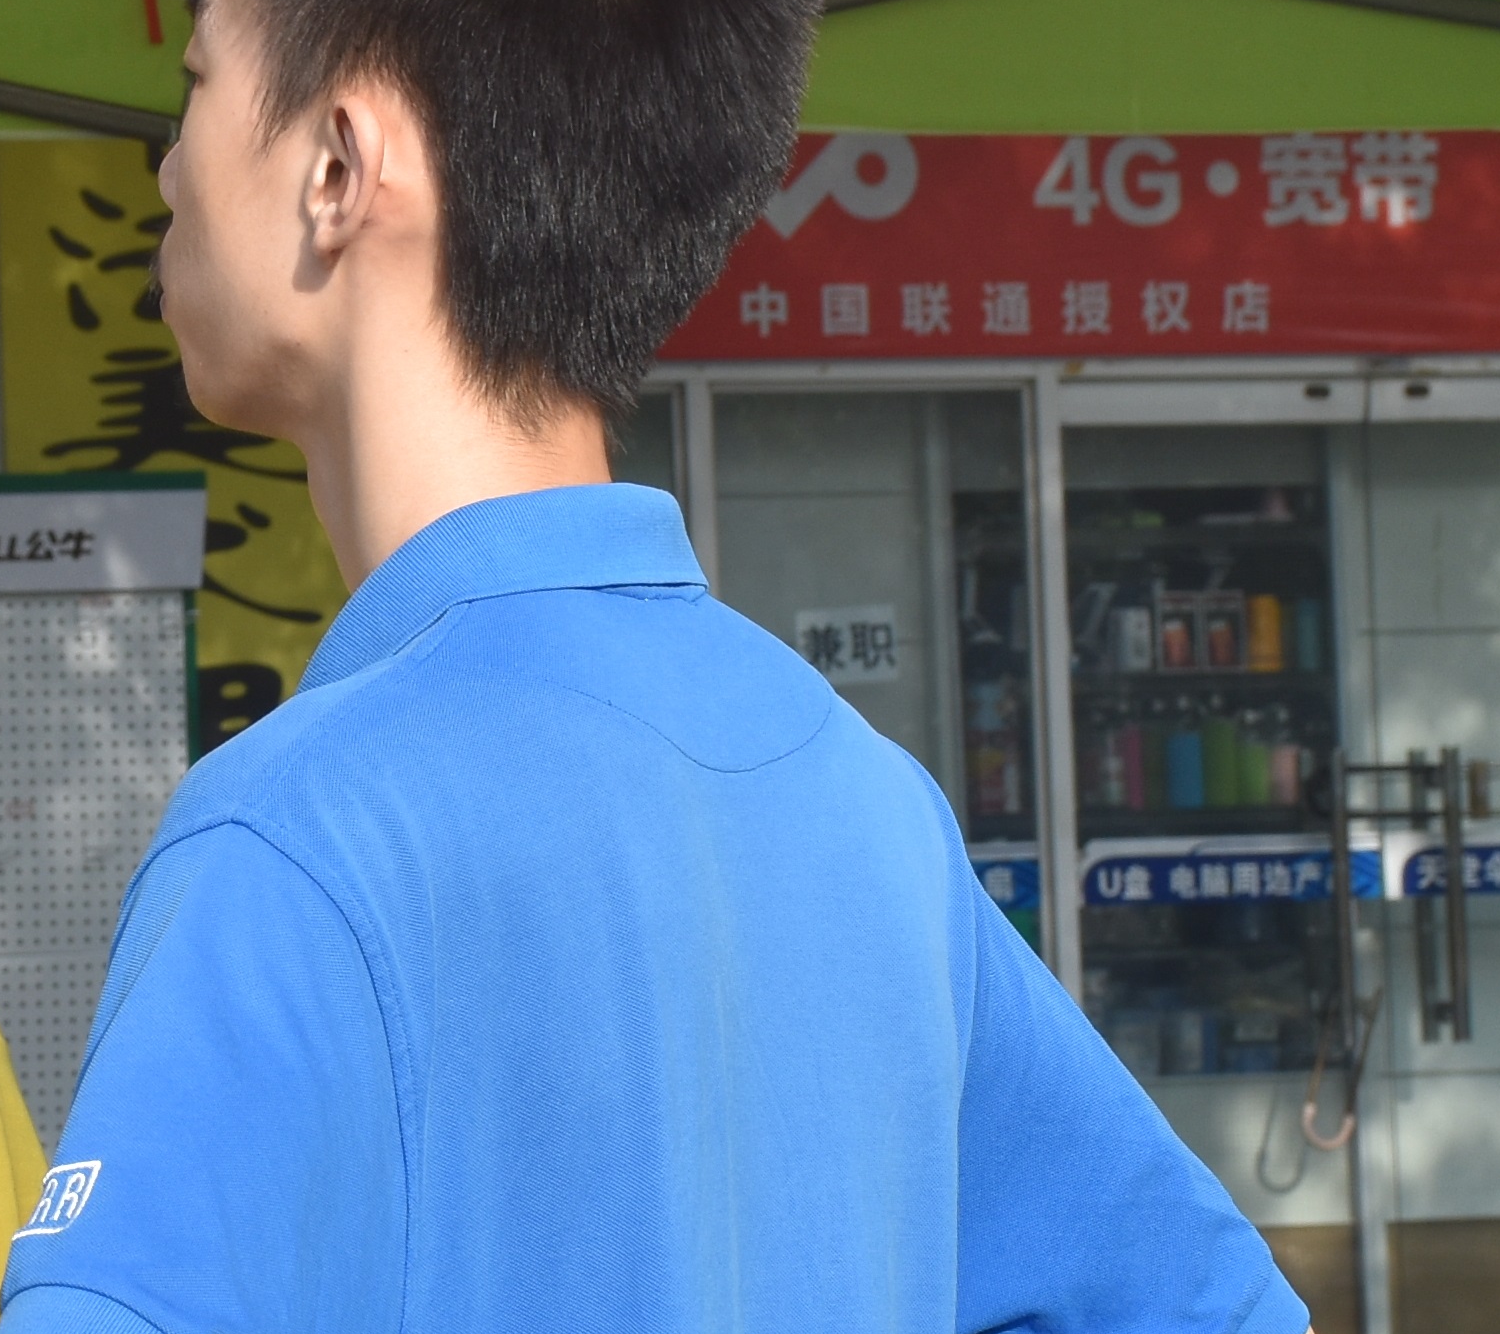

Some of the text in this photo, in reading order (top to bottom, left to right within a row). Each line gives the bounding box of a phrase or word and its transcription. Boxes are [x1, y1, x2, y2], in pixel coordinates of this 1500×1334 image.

[740, 280, 1271, 338] 中国联通授权店
[1170, 860, 1335, 900] 电脑周边产
